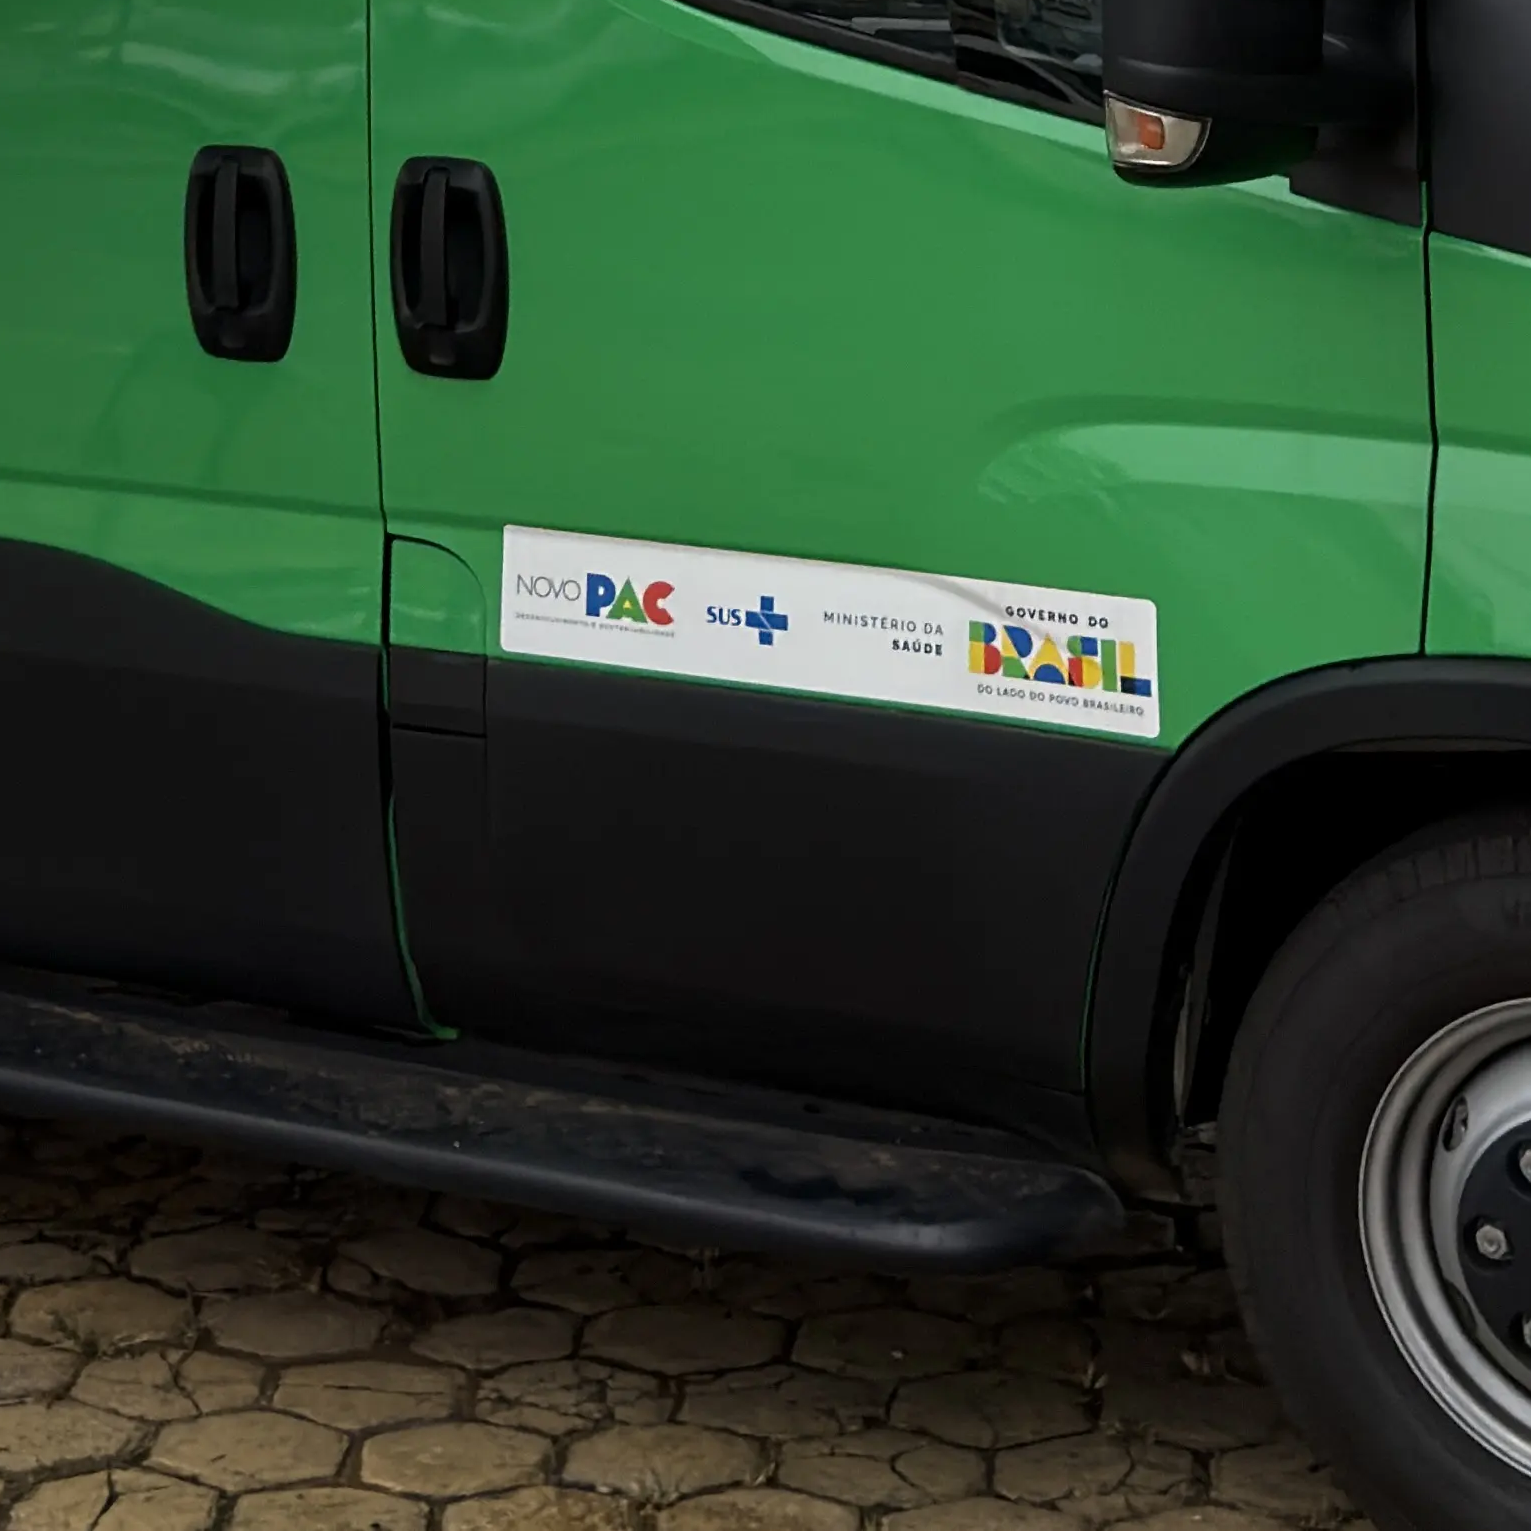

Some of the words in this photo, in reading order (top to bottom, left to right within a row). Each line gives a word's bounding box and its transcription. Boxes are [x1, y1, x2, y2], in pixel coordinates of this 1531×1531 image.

[516, 574, 581, 601] NOVO
[585, 572, 675, 626] PAC
[705, 605, 743, 627] SUS
[823, 610, 916, 633] MINISTÉRIO
[923, 622, 944, 636] DA
[1005, 605, 1079, 625] GOVERNO
[1087, 615, 1109, 629] DO
[891, 638, 944, 656] SAÚDE
[968, 620, 1152, 698] BRASIL
